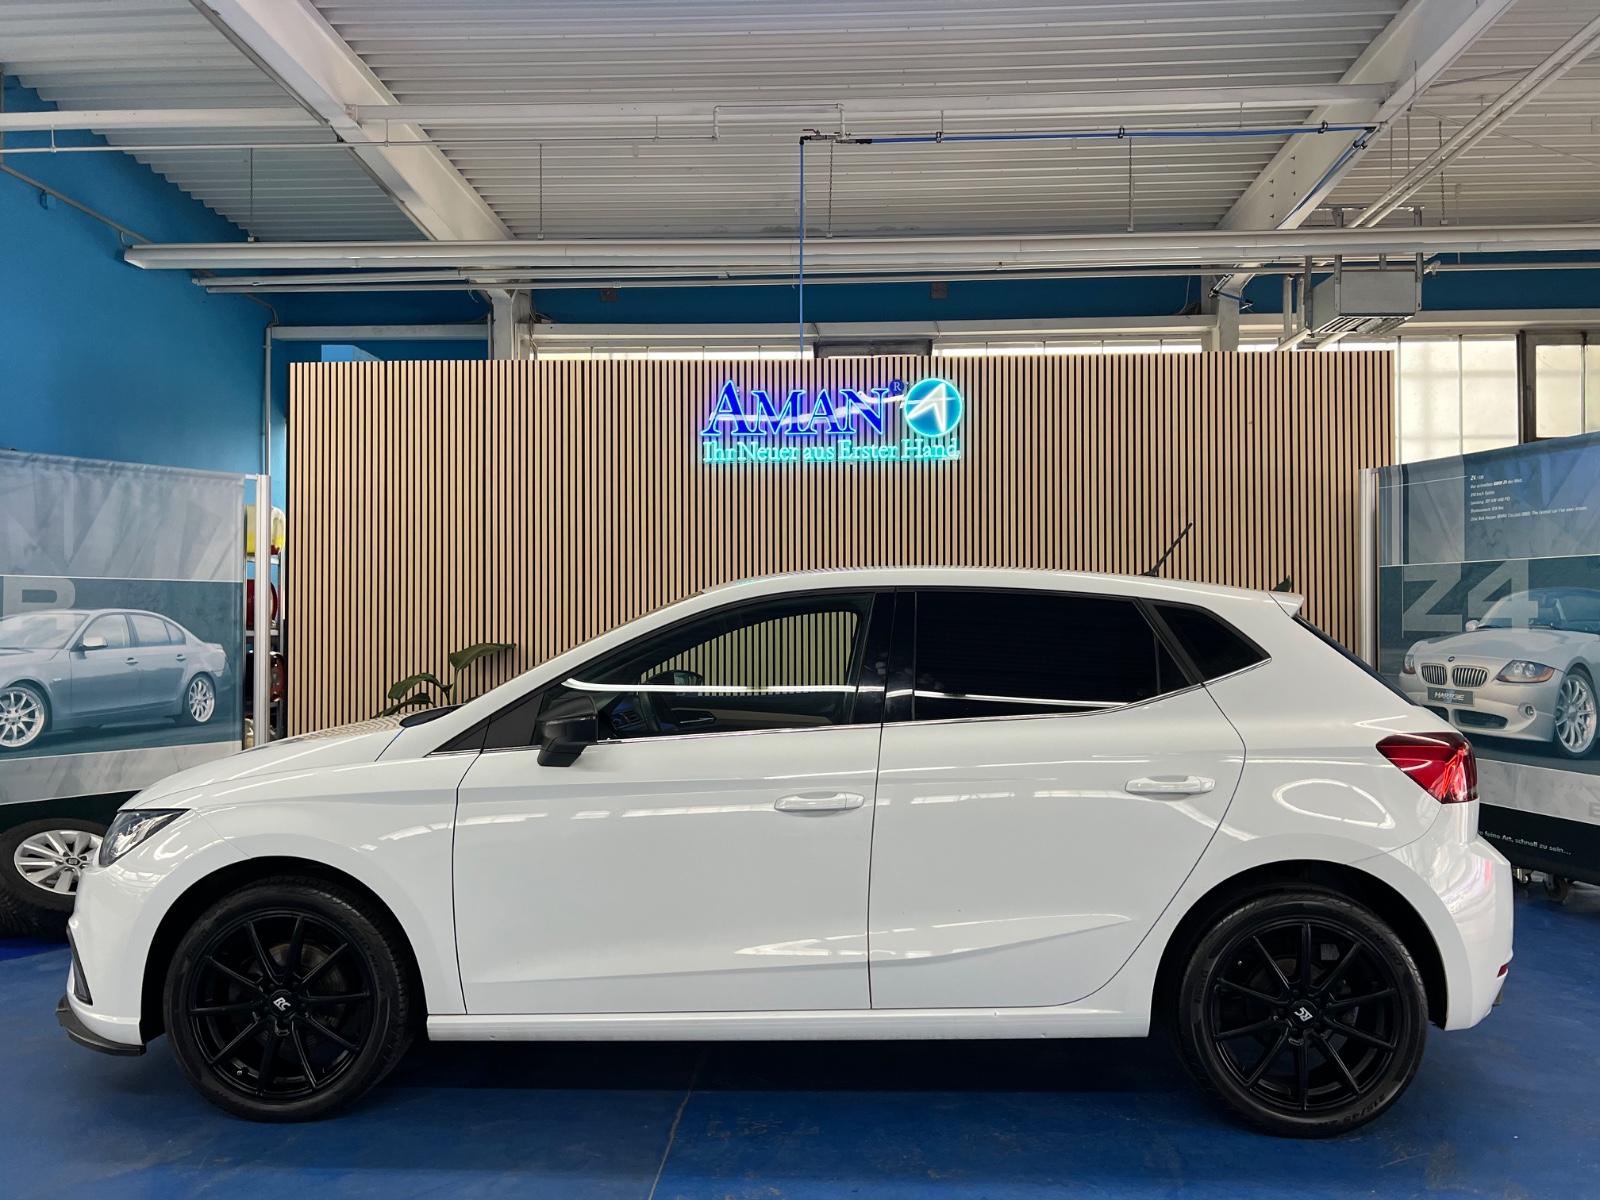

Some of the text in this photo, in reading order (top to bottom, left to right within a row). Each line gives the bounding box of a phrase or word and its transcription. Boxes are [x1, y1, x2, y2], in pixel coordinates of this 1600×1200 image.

[702, 437, 958, 462] Ihr Neuer aus Erster Hand
[1403, 559, 1538, 634] Z4
